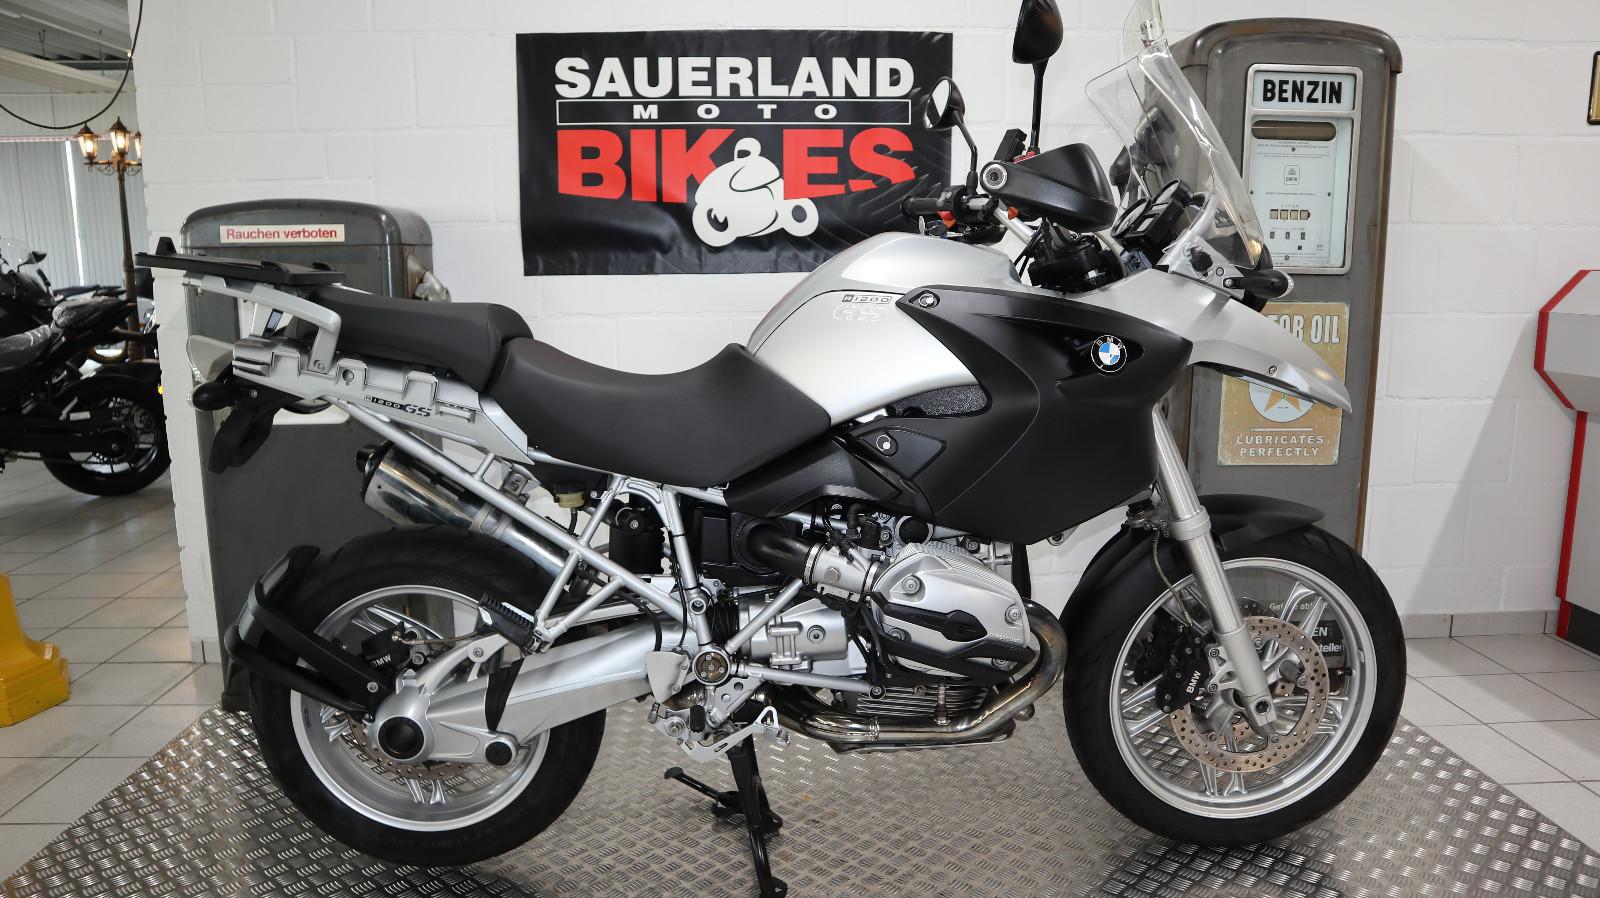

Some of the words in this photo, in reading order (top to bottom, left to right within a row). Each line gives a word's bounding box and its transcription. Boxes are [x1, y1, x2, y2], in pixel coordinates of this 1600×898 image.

[554, 56, 914, 98] SAUERLAND
[1262, 79, 1342, 104] BENZIN
[632, 103, 838, 120] MOTO
[226, 228, 280, 240] Rauchen
[283, 227, 337, 239] verboten
[1310, 313, 1340, 344] OIL
[1096, 336, 1124, 350] BMW
[1236, 435, 1324, 445] LUBRICATES
[1239, 447, 1320, 457] PERFECTLY
[1185, 670, 1201, 694] BMW
